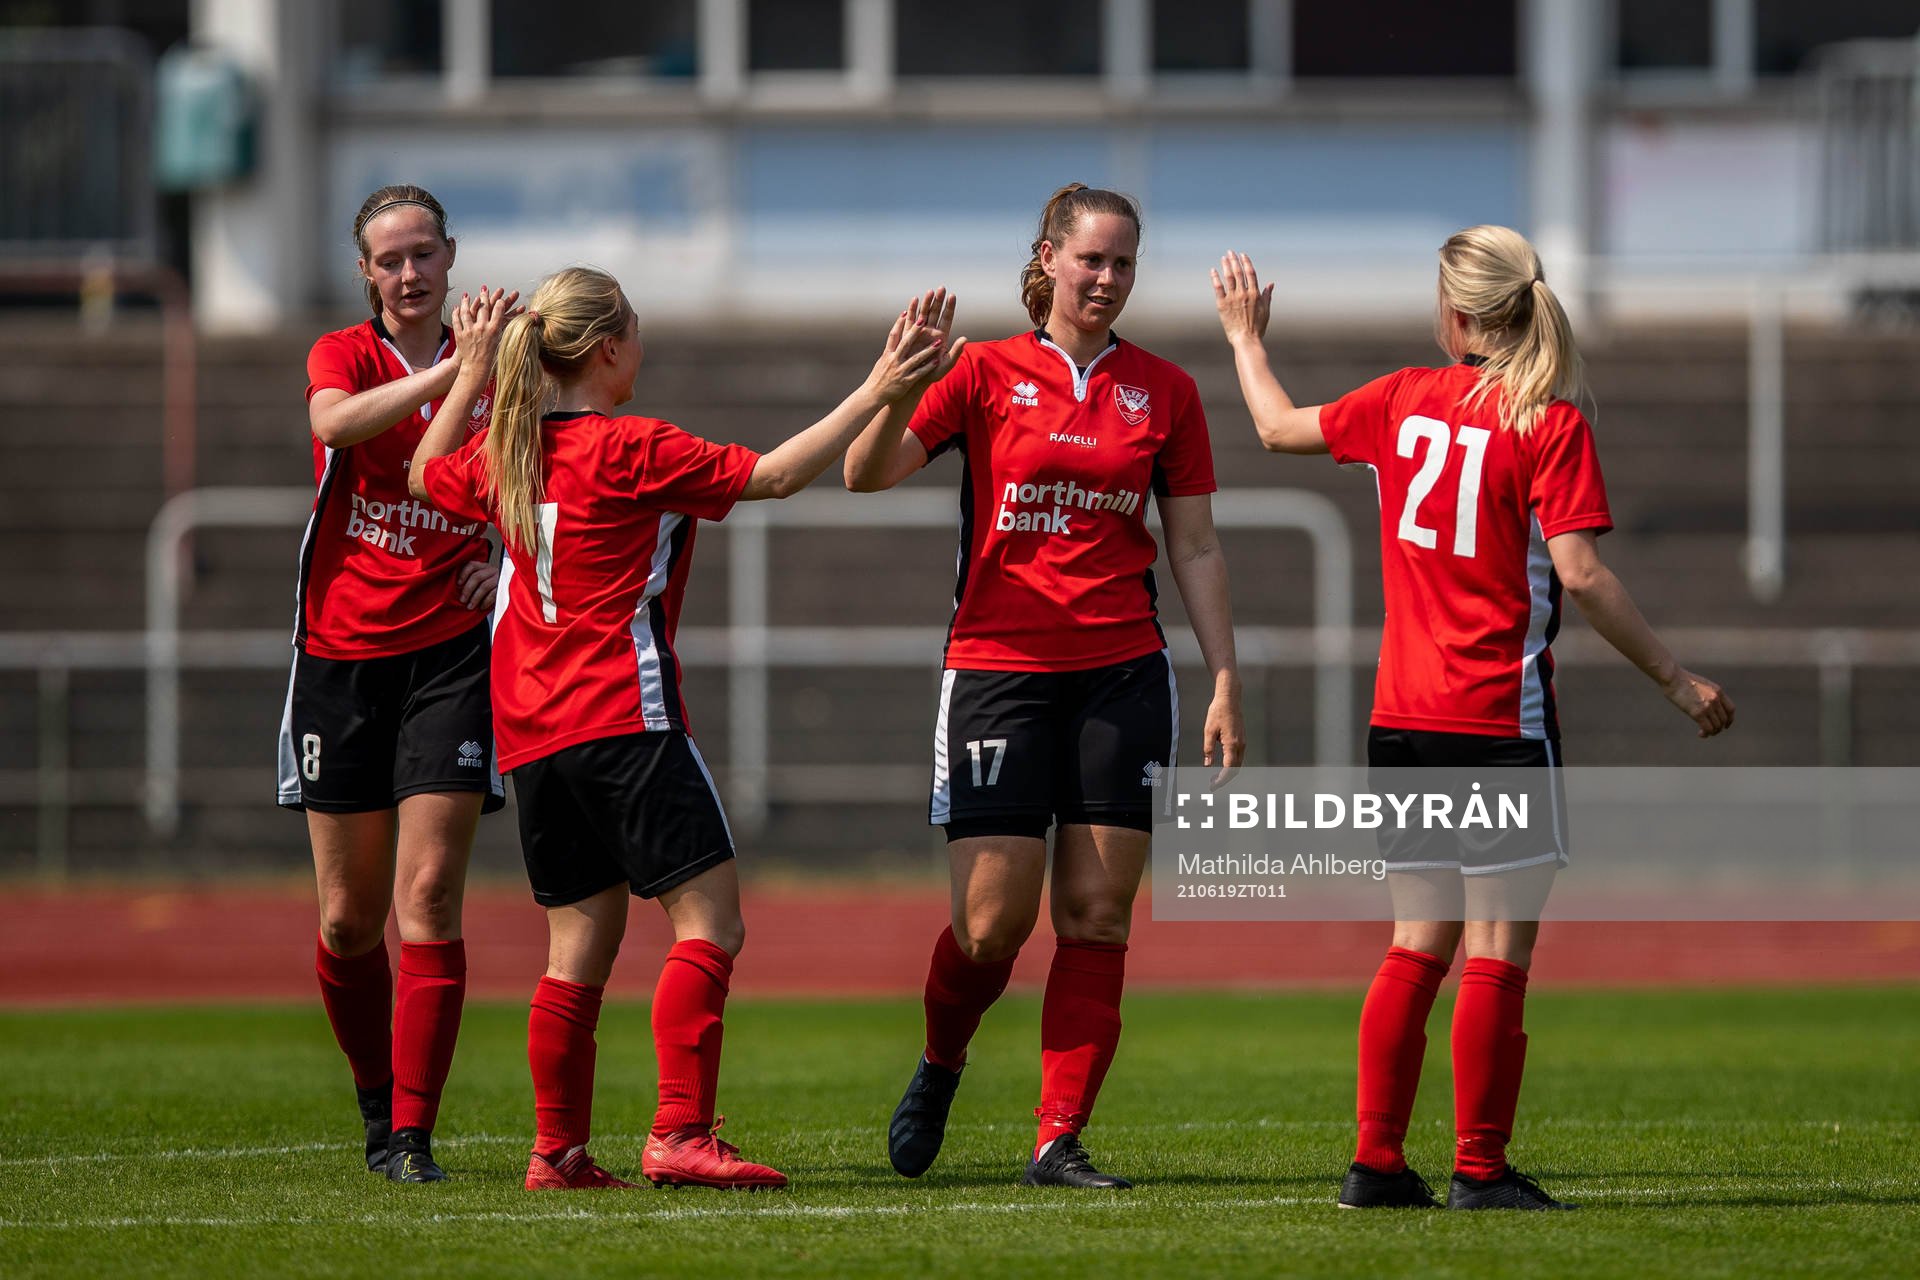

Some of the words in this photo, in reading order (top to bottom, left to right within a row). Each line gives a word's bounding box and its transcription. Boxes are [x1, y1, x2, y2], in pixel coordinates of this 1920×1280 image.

[1050, 433, 1097, 446] RAVELLI
[1002, 481, 1140, 516] northmill
[1397, 415, 1491, 558] 21
[346, 510, 416, 555] bank
[352, 493, 478, 535] northm
[996, 504, 1072, 534] bank
[302, 733, 321, 781] 8
[966, 739, 1007, 787] 17
